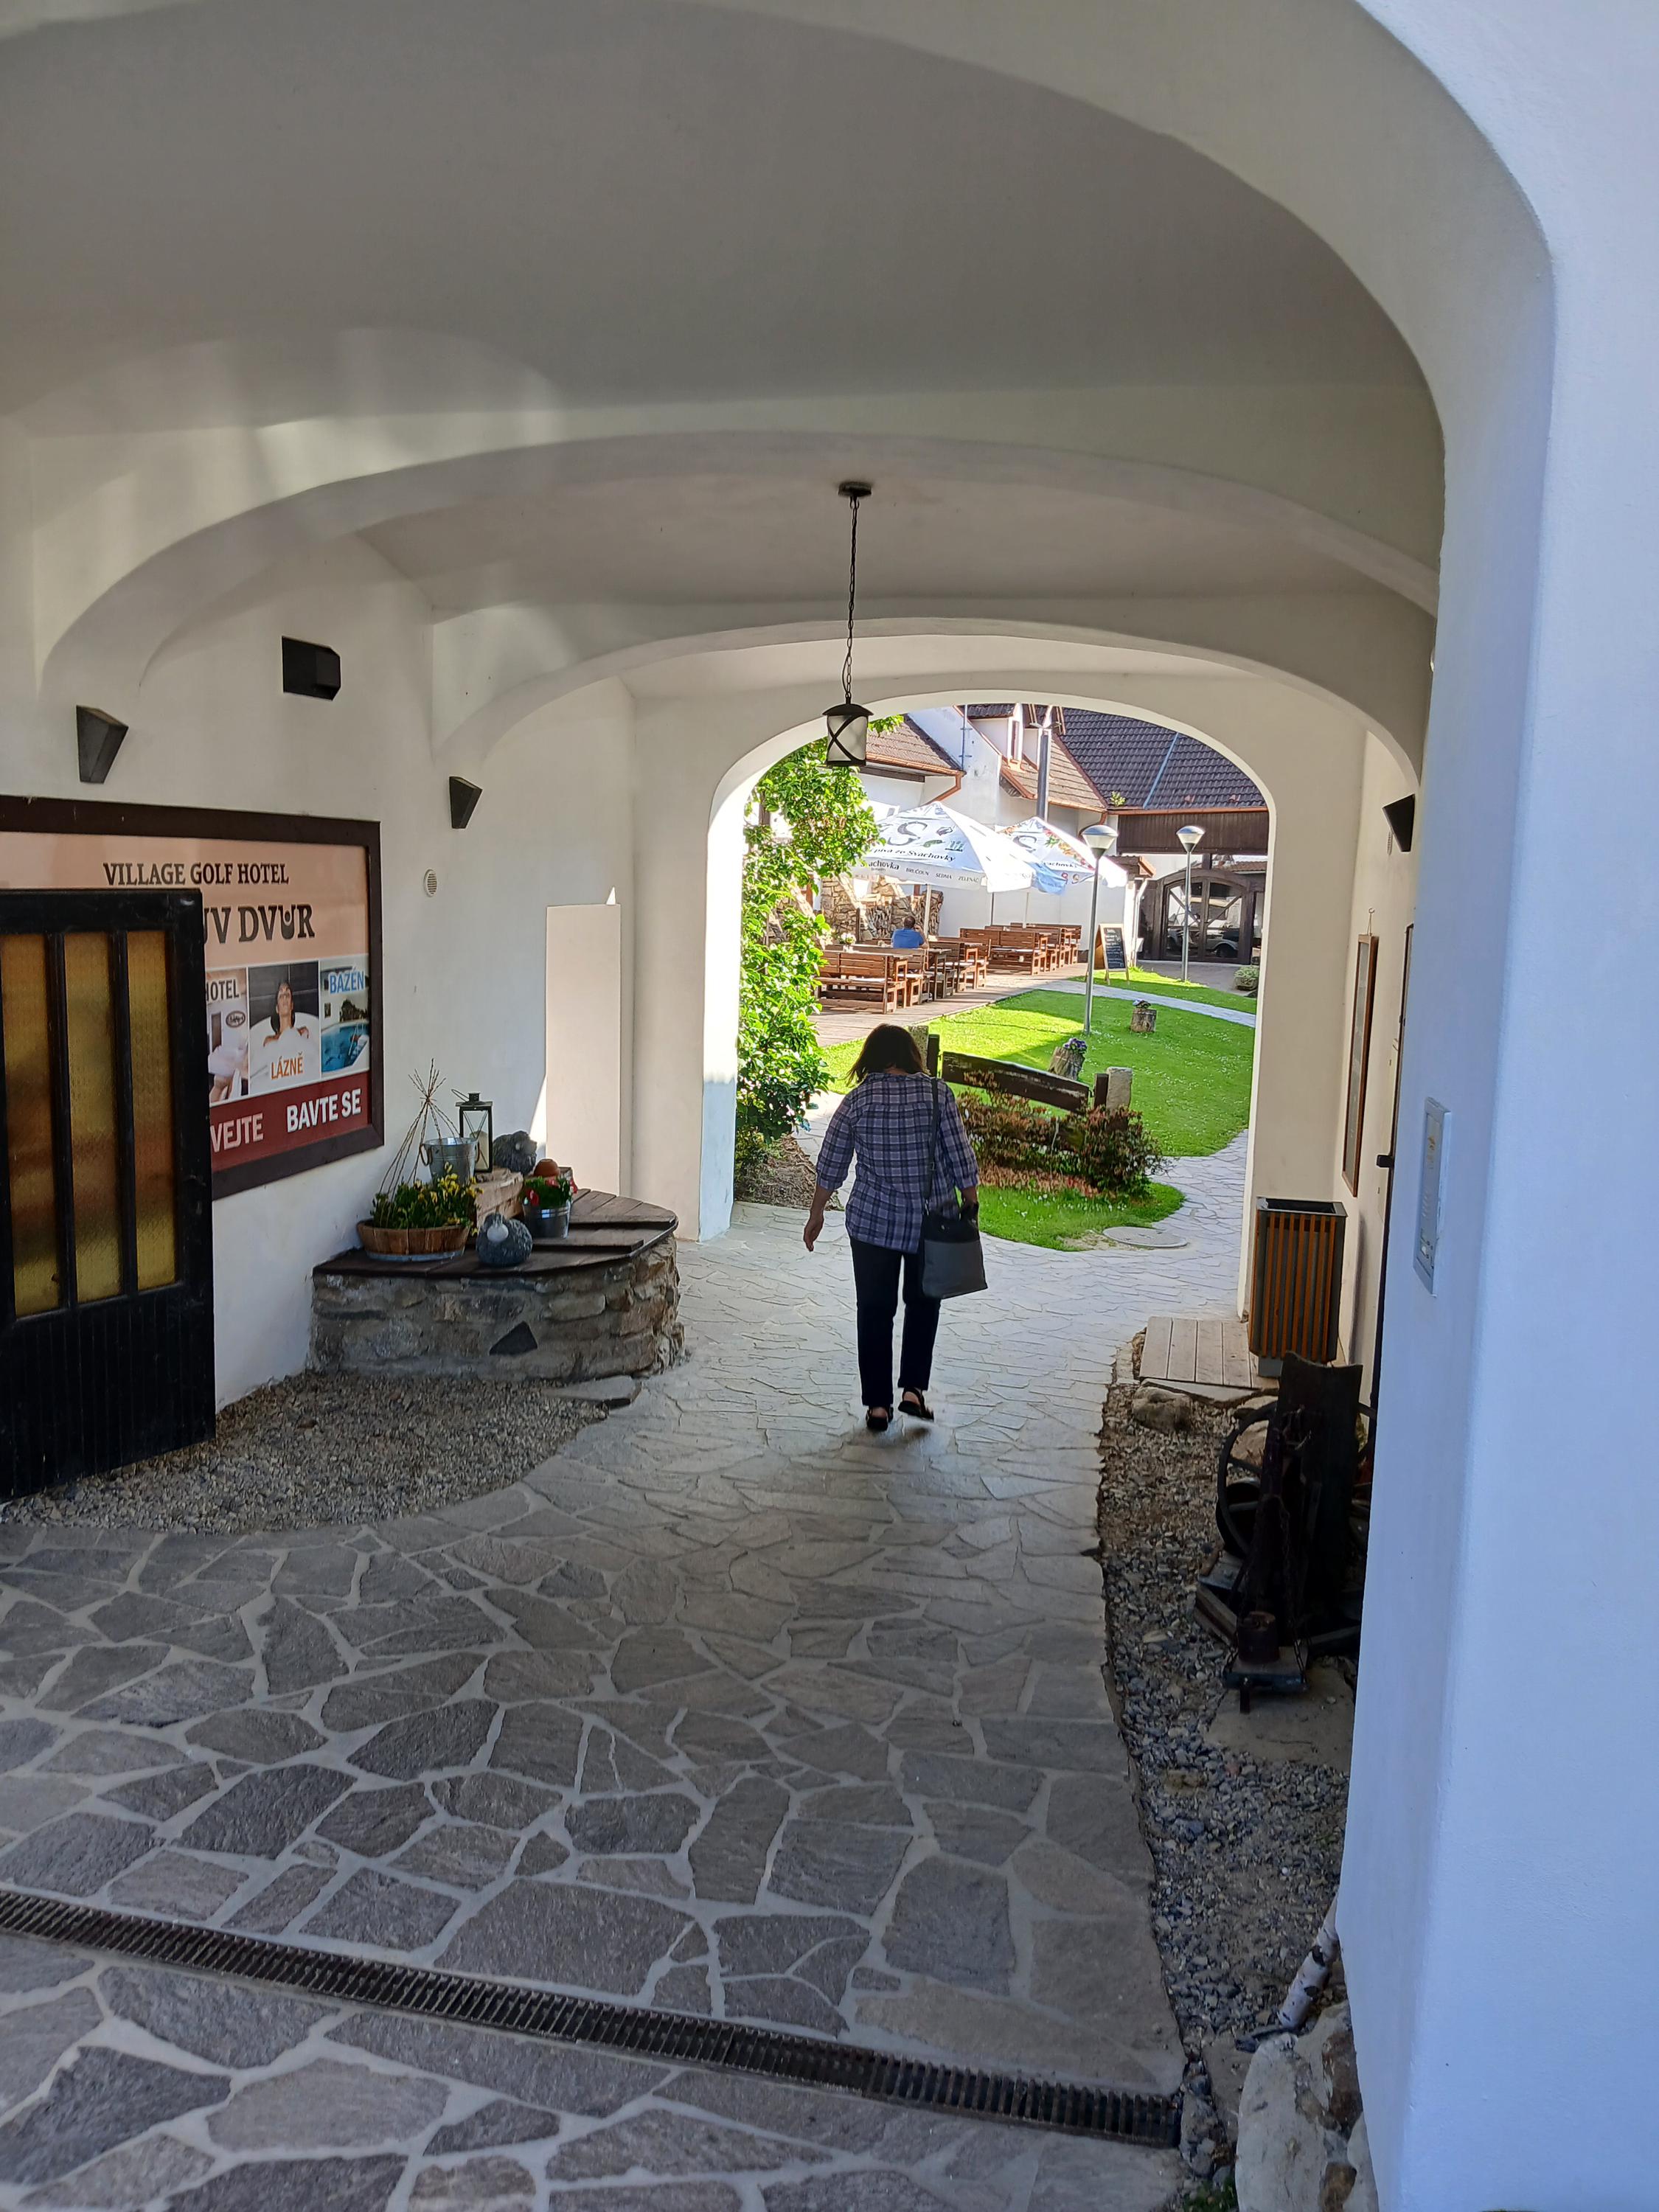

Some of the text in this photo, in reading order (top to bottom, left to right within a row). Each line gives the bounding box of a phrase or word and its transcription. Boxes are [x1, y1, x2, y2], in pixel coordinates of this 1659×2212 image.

[103, 863, 289, 886] VILLAGE GOLF HOTEL
[860, 860, 900, 870] achovka
[330, 967, 364, 994] BAZÉN
[271, 1051, 304, 1080] LÁZNĚ
[287, 1094, 338, 1133] BAVTE
[341, 1088, 361, 1118] SE
